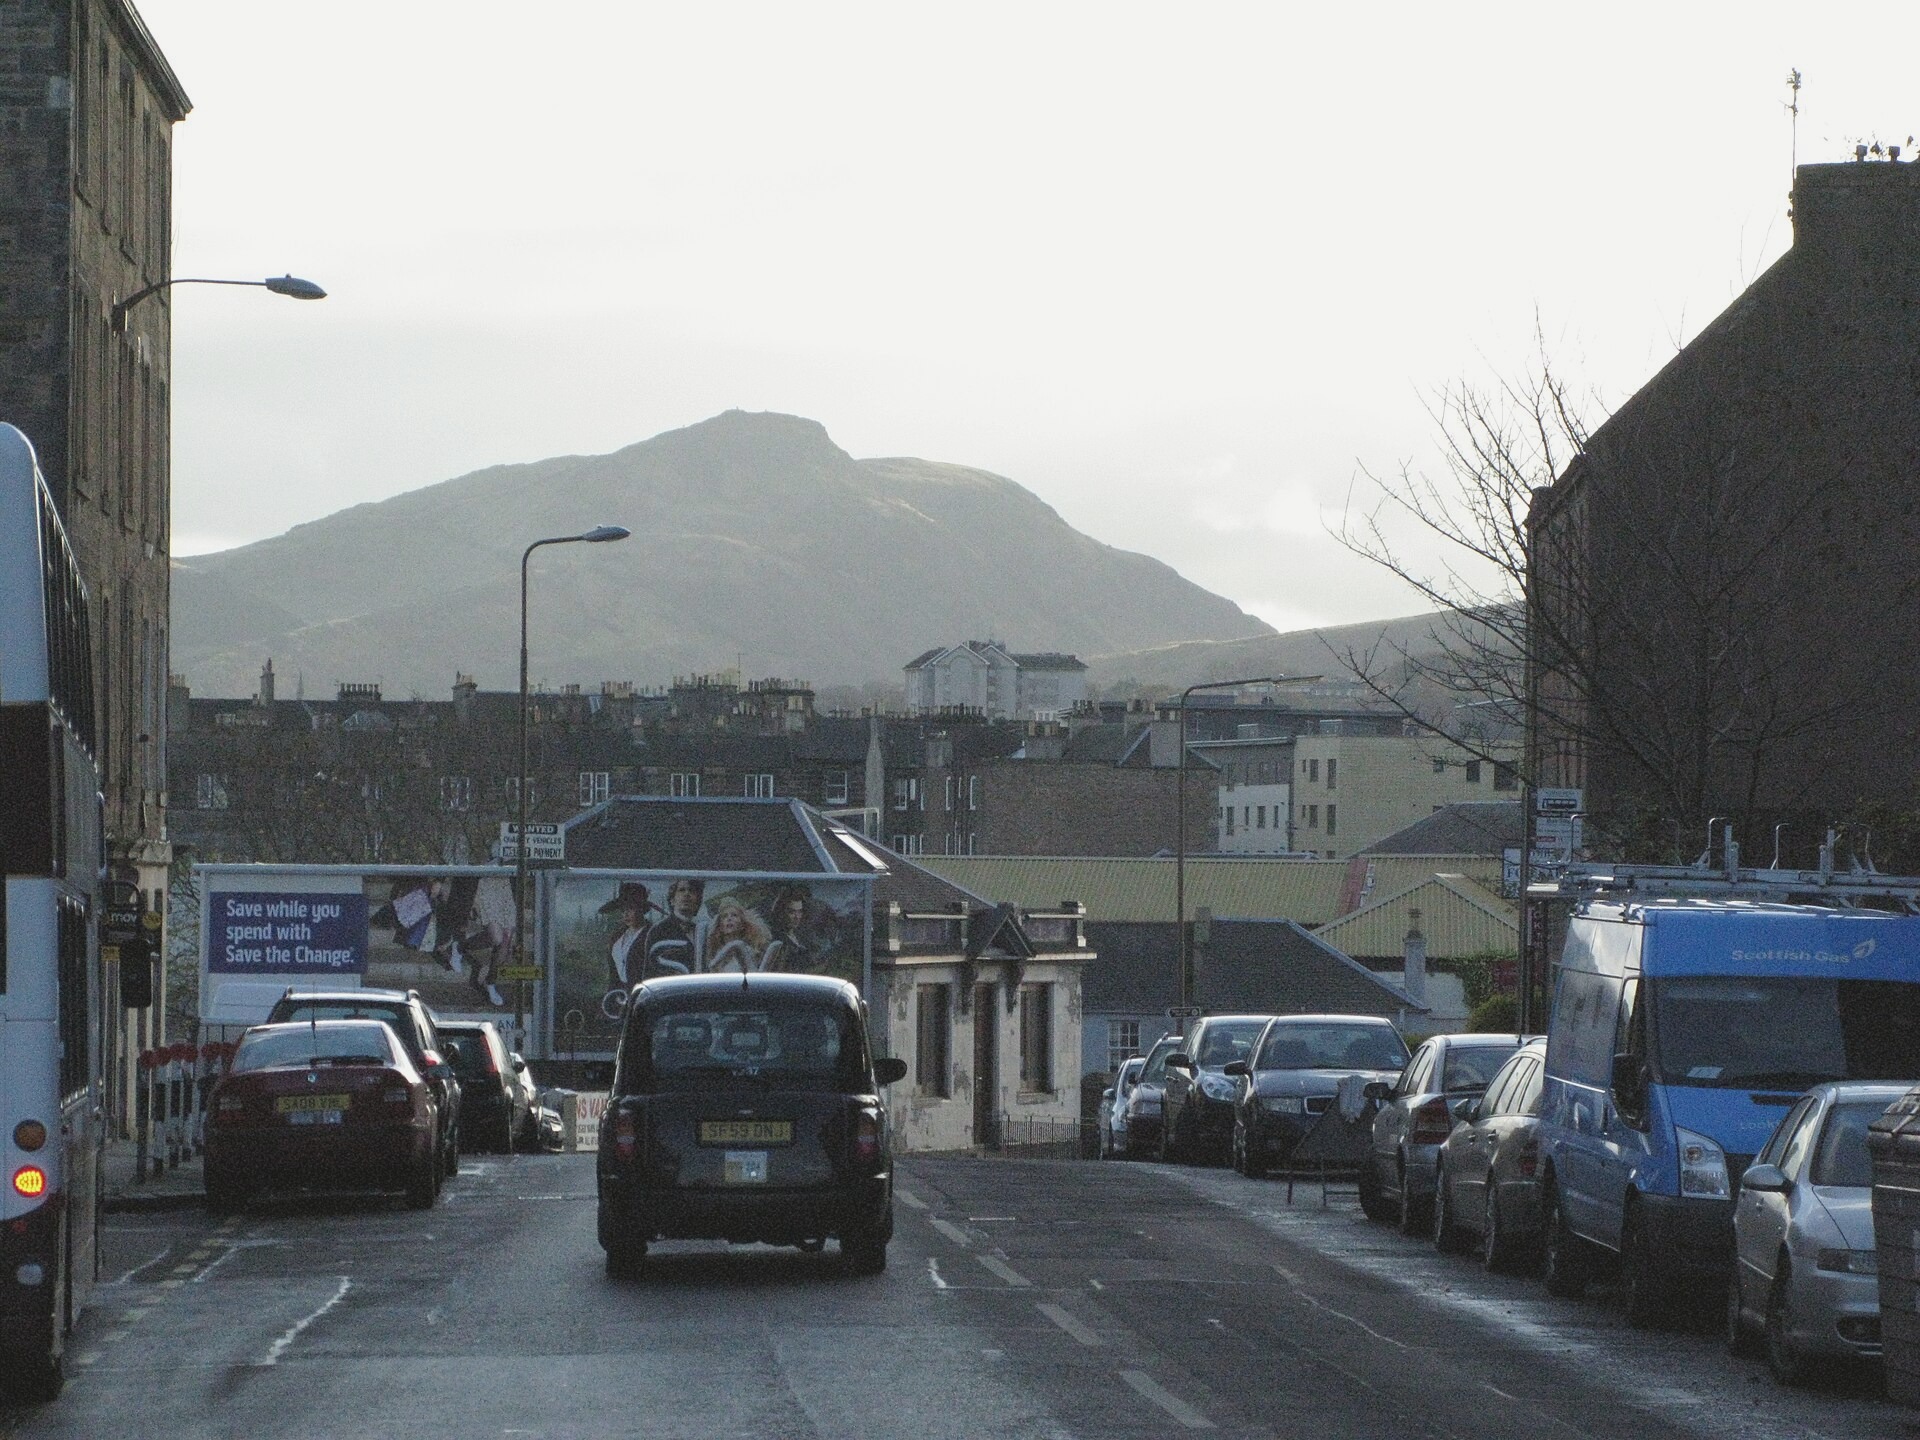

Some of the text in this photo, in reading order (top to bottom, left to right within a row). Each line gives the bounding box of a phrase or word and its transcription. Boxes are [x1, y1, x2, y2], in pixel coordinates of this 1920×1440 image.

[511, 825, 555, 833] WNTED
[226, 899, 340, 922] Save while you
[226, 922, 310, 944] spend with
[225, 944, 262, 962] Save
[266, 944, 291, 962] the
[1731, 948, 1850, 964] Scottish Gas
